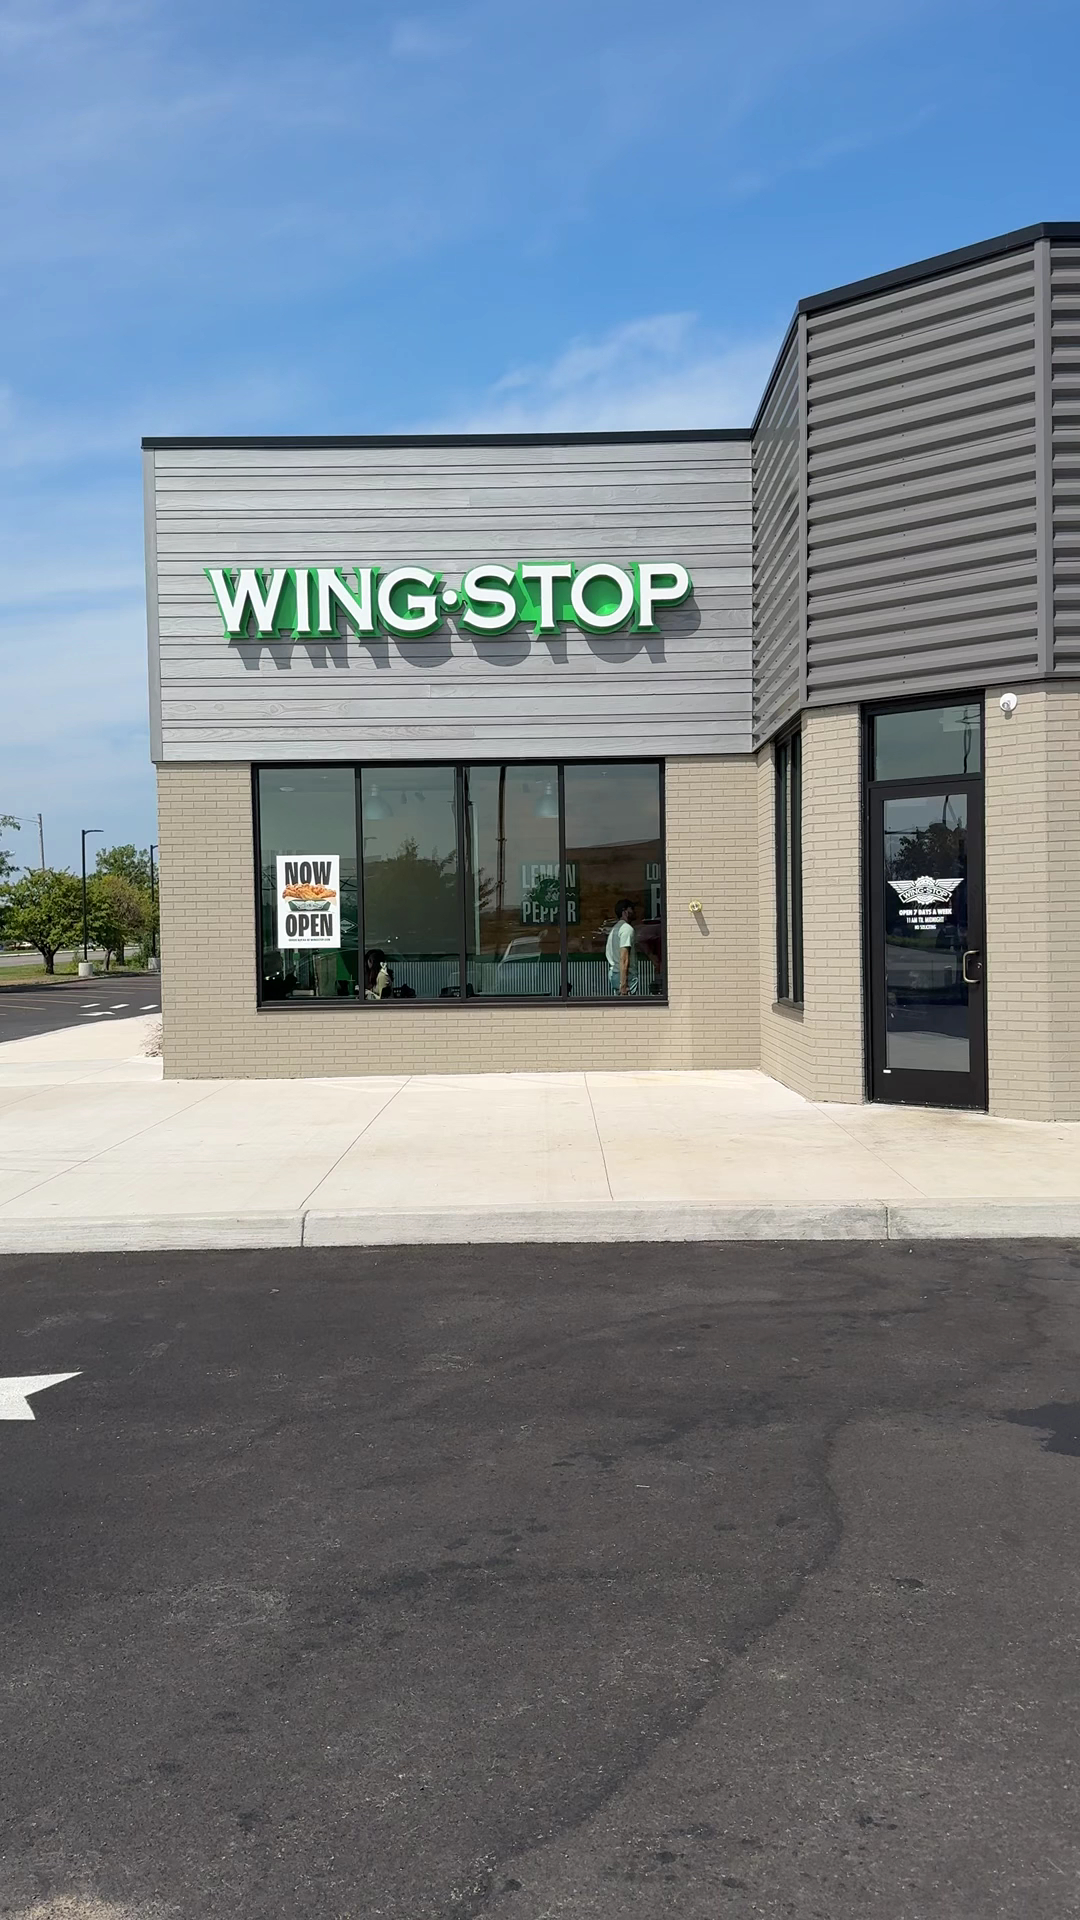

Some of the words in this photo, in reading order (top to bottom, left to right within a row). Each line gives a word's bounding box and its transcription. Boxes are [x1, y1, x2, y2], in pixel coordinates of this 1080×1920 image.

[284, 861, 332, 885] NOW
[522, 901, 576, 923] PEPPR
[285, 914, 333, 937] OPEN
